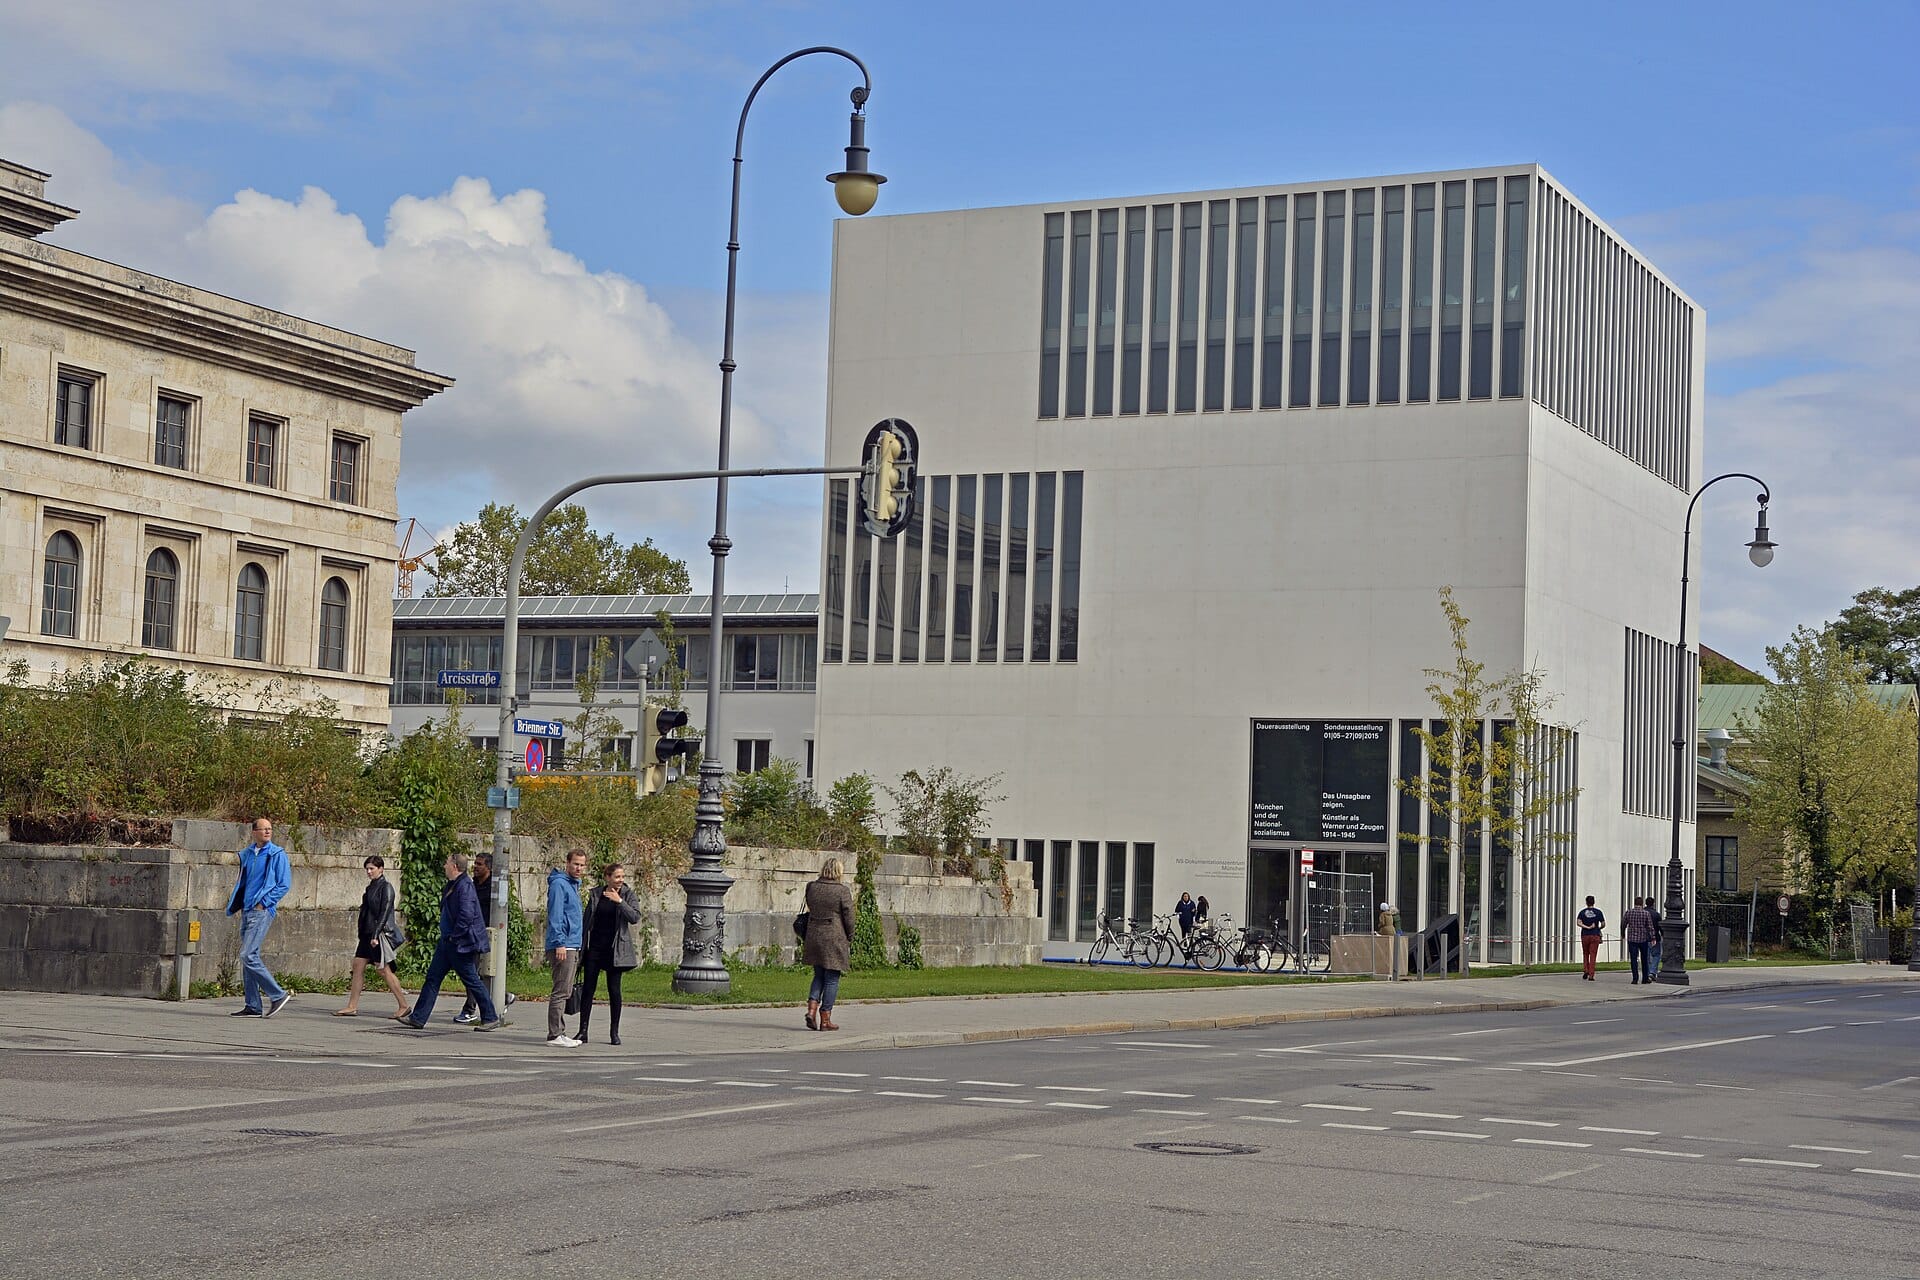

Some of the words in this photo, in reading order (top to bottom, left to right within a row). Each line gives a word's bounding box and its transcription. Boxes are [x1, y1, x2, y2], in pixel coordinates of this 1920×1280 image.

[440, 672, 497, 686] Arcisstraße
[517, 719, 547, 734] Brienner
[548, 723, 561, 735] Str.
[1256, 723, 1310, 731] Dauerausstellung
[1324, 723, 1384, 731] Sonderausstellung
[1336, 792, 1371, 800] Unsagbare
[1360, 823, 1384, 831] Zeugen
